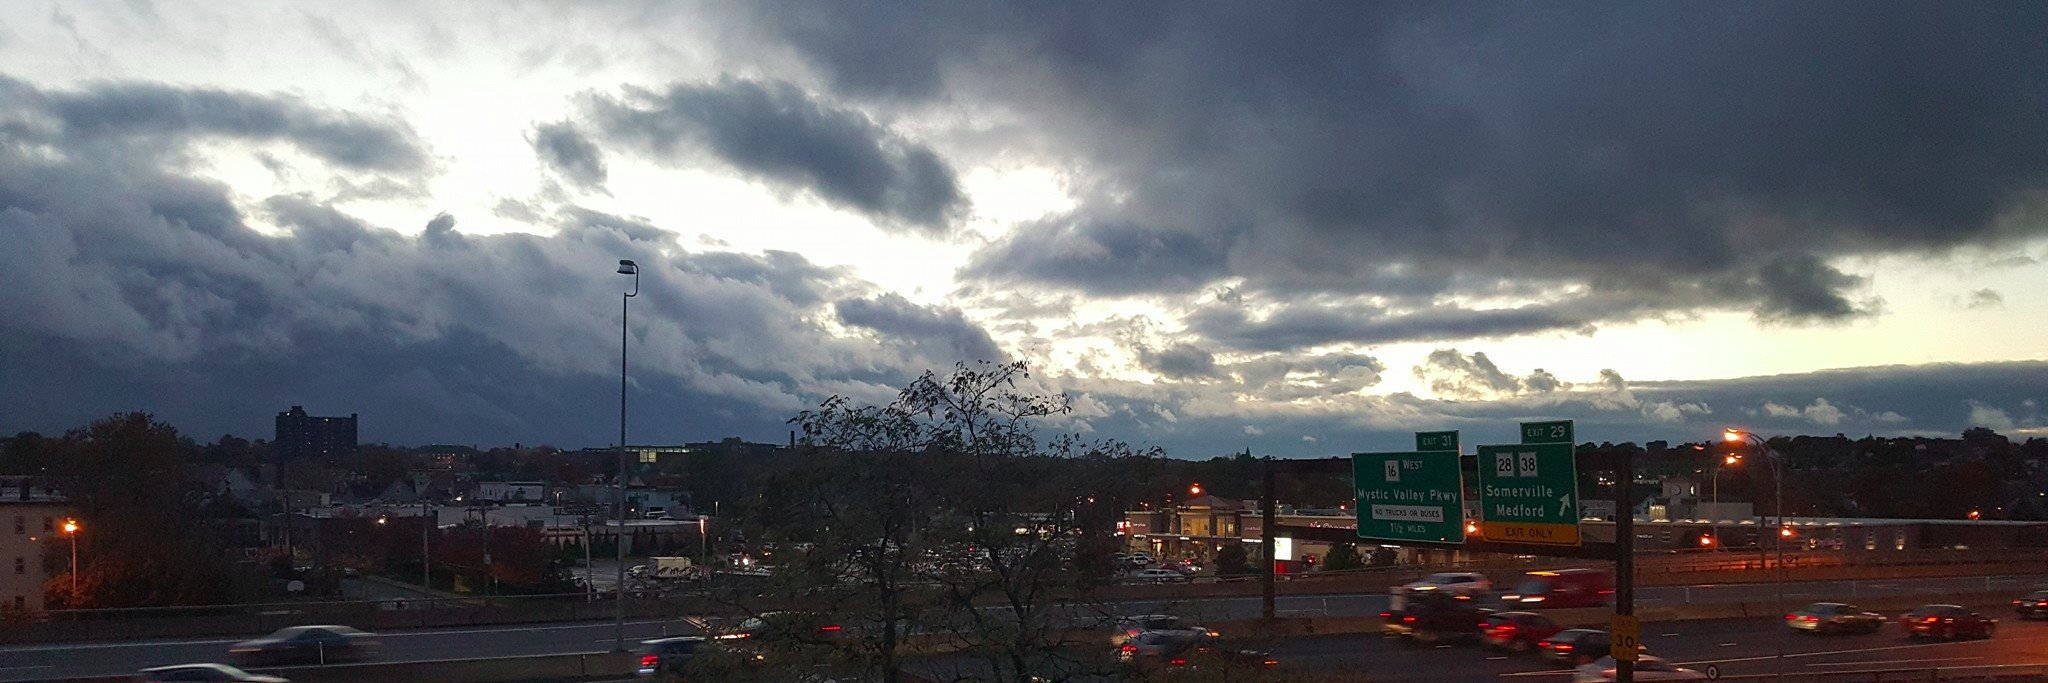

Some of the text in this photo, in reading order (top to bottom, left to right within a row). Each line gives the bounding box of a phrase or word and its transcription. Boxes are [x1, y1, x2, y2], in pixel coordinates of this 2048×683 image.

[1527, 426, 1565, 438] EXIT 29
[1423, 435, 1452, 446] EXIT 31
[1498, 457, 1535, 471] 28 38
[1388, 465, 1397, 477] 16
[1358, 488, 1457, 504] Mystic Valley Pkwy
[1486, 485, 1553, 497] Somerville
[1375, 508, 1440, 518] NO TRUCKS OR BUSES
[1496, 504, 1544, 517] Medford
[1407, 524, 1426, 533] MILES
[1505, 528, 1554, 539] EXIT ONLY
[1616, 634, 1634, 648] 30
